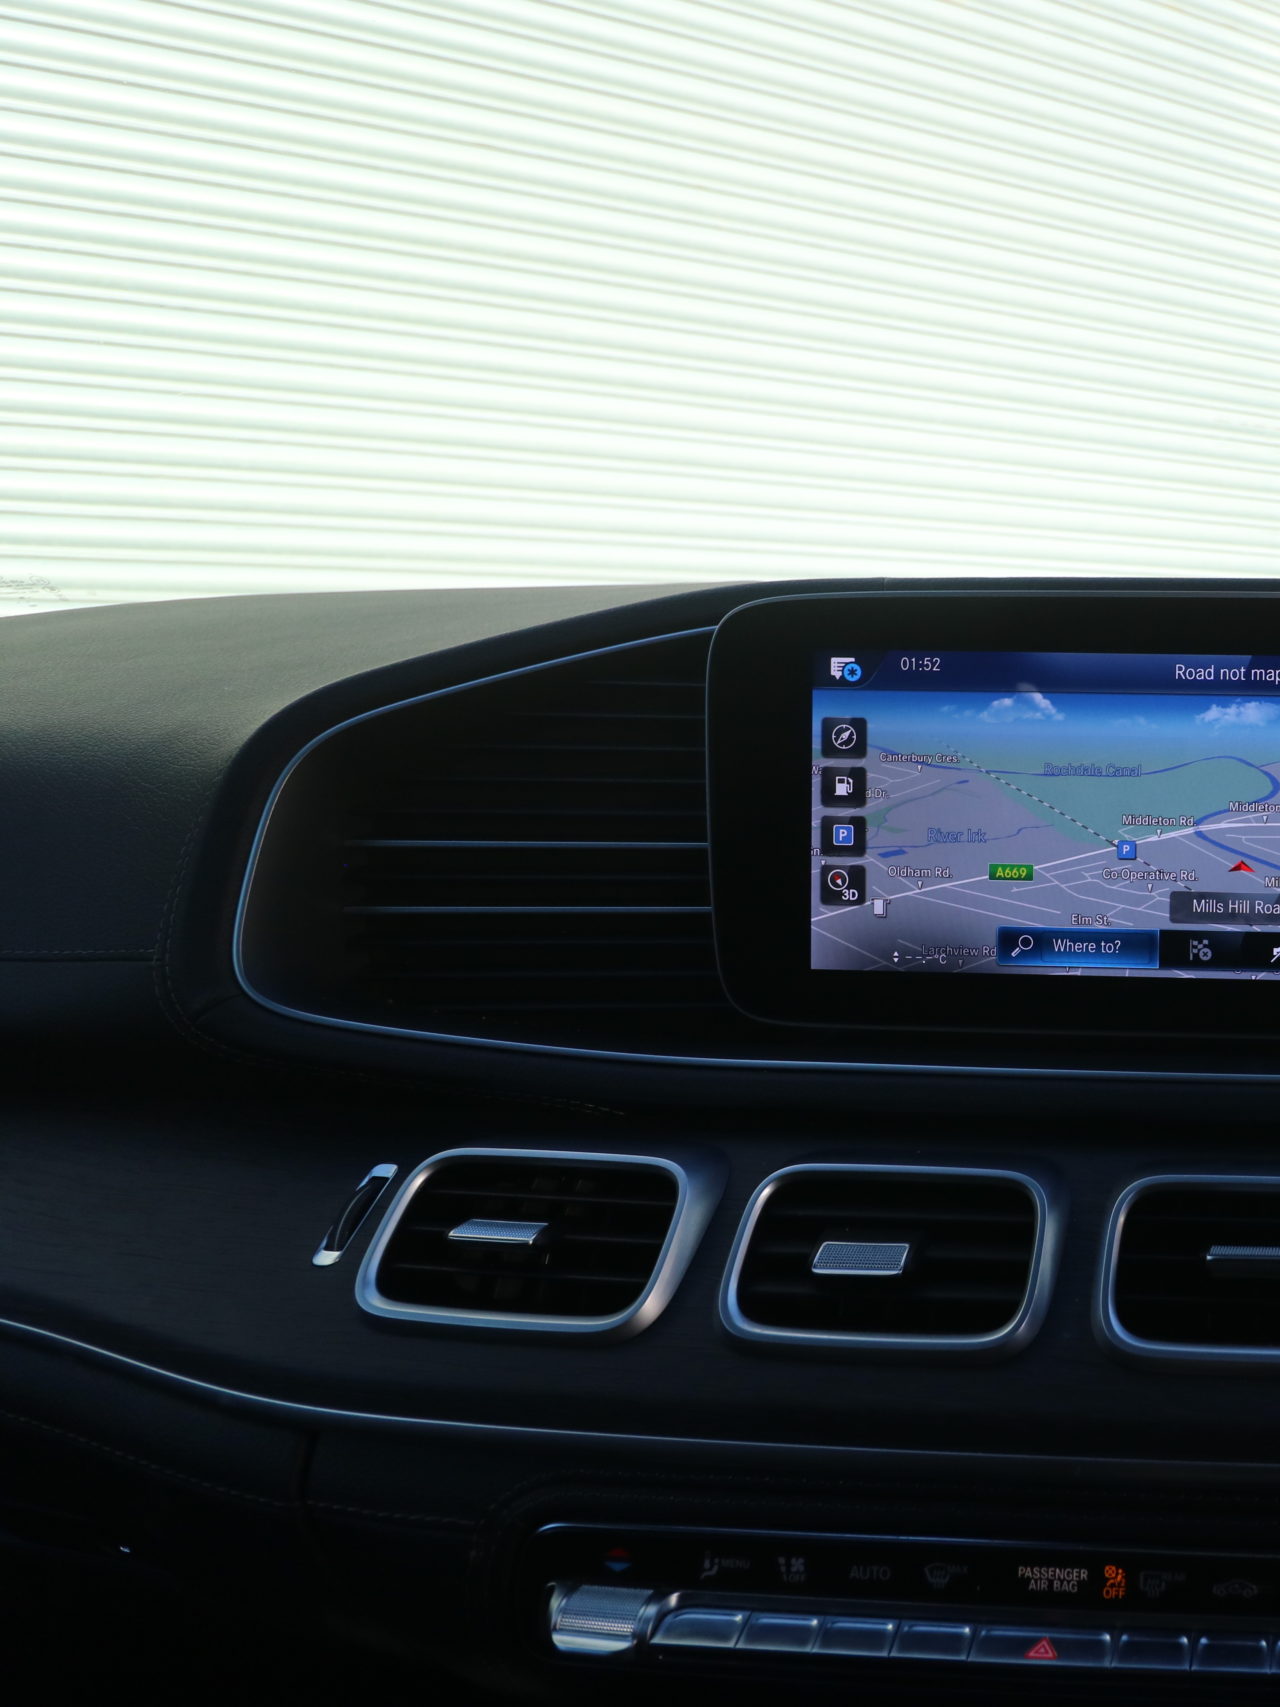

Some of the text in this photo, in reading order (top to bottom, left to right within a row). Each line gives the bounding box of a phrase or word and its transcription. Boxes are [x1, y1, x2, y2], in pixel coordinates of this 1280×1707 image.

[900, 657, 941, 671] 01:52
[1175, 664, 1214, 680] Road
[1220, 666, 1246, 681] not
[880, 752, 960, 764] Canterbury Cres.
[1044, 762, 1142, 777] Rochdale Canal
[875, 789, 889, 799] Dr.
[1122, 815, 1197, 827] Middleton Rd.
[839, 829, 848, 841] P
[928, 828, 987, 843] River Irk
[1122, 845, 1130, 855] P
[888, 866, 953, 878] Oldham Rd.
[996, 868, 1027, 879] A669
[1180, 871, 1199, 881] Rd.
[842, 890, 858, 901] 3D
[1193, 899, 1223, 914] Mills
[1228, 900, 1250, 914] Hill
[1071, 914, 1112, 926] Elm St.
[922, 944, 979, 956] Larchview
[1053, 939, 1121, 954] Where to?
[721, 1557, 751, 1569] MENU
[848, 1565, 891, 1581] AUTO
[1018, 1565, 1088, 1581] PASSENGER
[1028, 1580, 1078, 1593] AIR BAG
[1103, 1587, 1126, 1600] OFF
